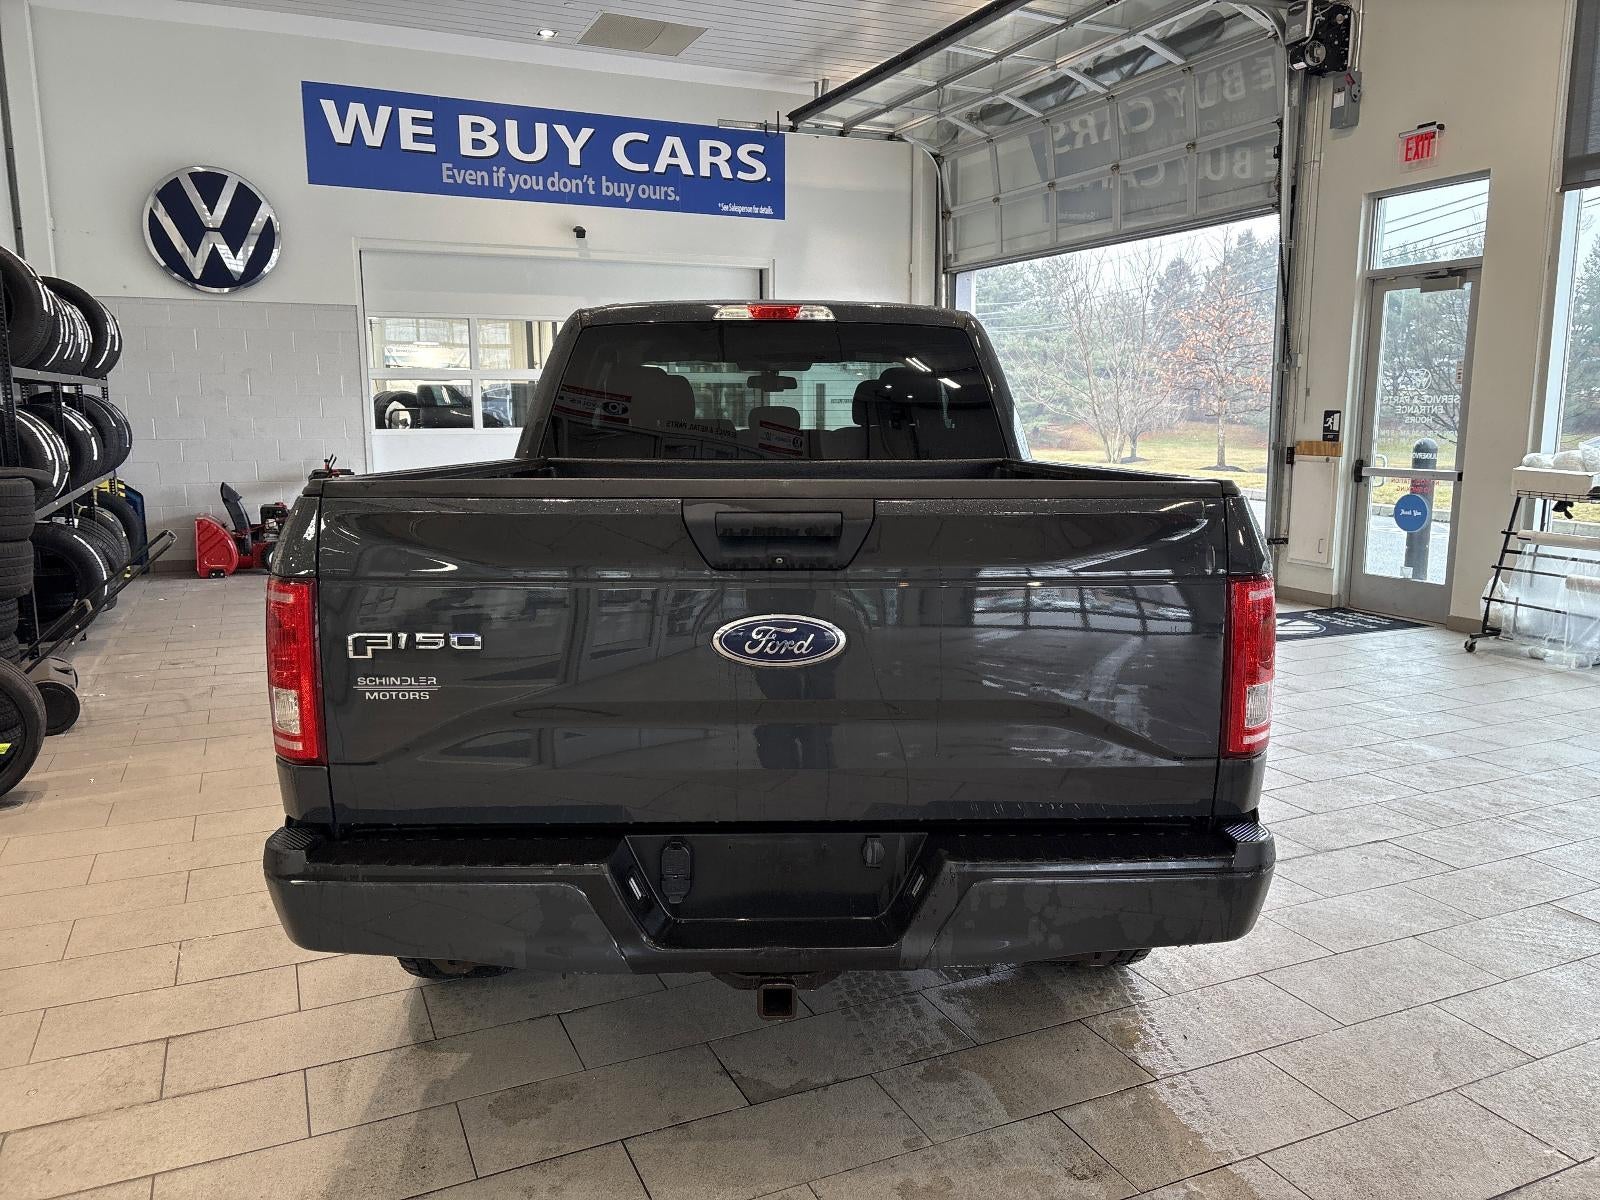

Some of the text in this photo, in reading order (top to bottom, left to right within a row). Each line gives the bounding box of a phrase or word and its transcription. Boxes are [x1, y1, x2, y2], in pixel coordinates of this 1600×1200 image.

[319, 98, 772, 183] WE BUY CARS.
[1405, 134, 1434, 162] EXIT
[441, 162, 680, 203] Even if you don't buy ours.
[728, 202, 753, 214] Salesperson
[744, 625, 815, 655] Ford
[357, 676, 437, 686] SCHINDLER
[365, 691, 430, 701] MOTORS
